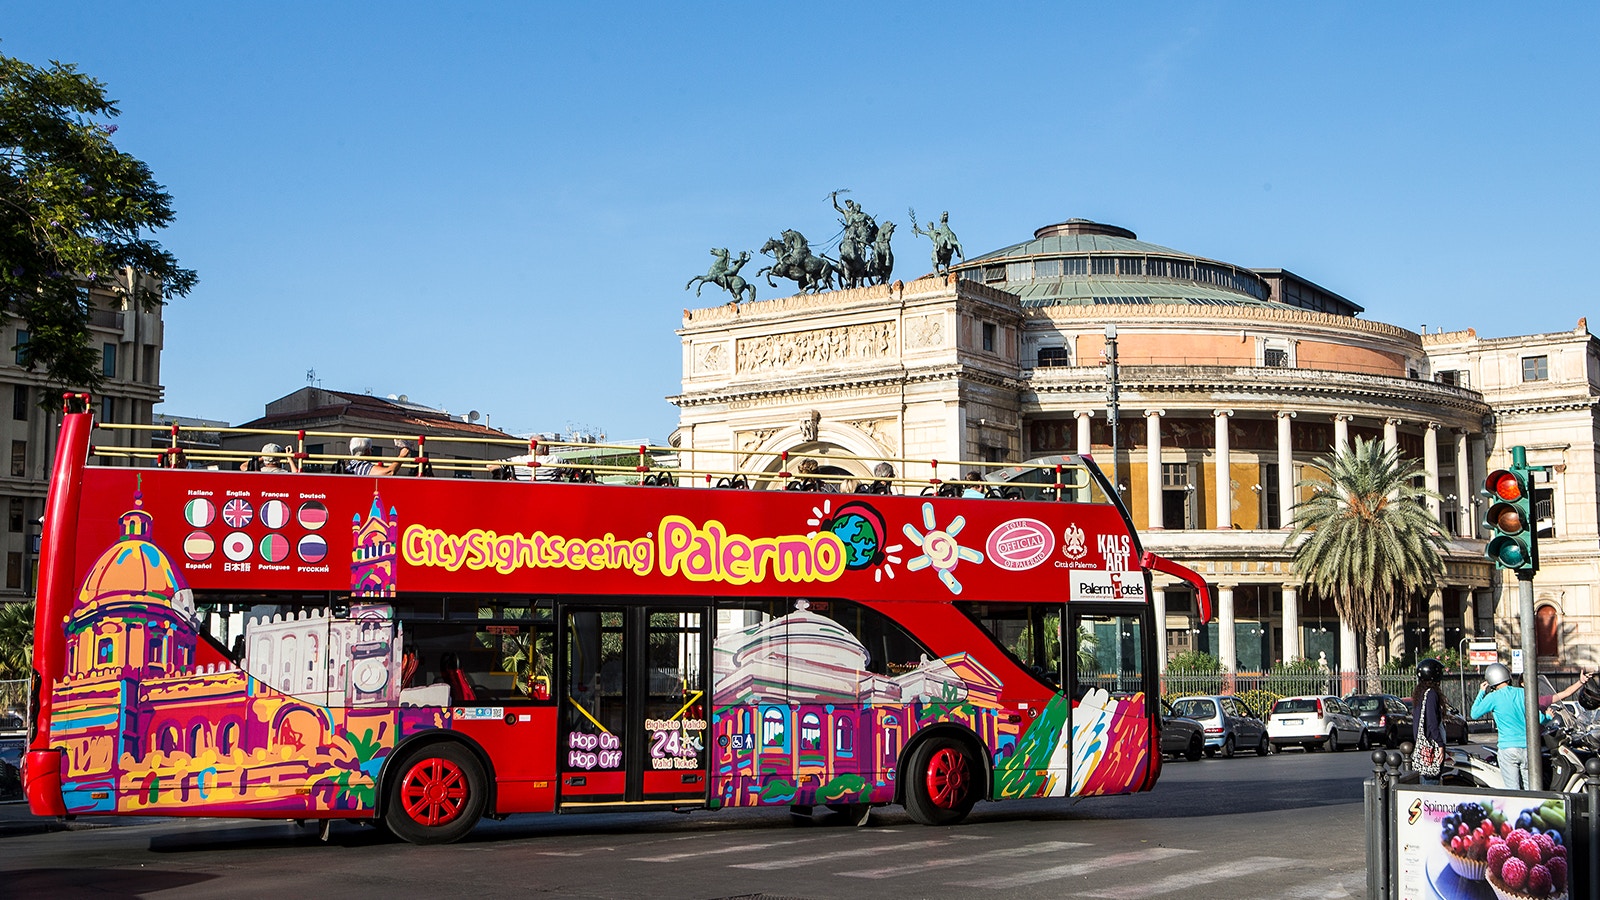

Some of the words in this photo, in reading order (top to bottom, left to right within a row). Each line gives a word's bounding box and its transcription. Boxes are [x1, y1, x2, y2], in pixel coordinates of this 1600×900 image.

[226, 490, 251, 498] English
[1005, 521, 1028, 532] TOUR
[658, 515, 847, 585] Palermo
[999, 535, 1043, 554] OFFICIAL
[1097, 534, 1130, 554] KALS
[1004, 559, 1015, 568] OF
[1015, 551, 1045, 568] PALERMO
[1054, 560, 1069, 568] Città
[1075, 561, 1097, 569] Palermo
[185, 562, 212, 570] Español
[224, 562, 251, 572] 日本語
[645, 719, 680, 731] Biglietto
[682, 719, 707, 730] Valido
[569, 731, 599, 751] Hop
[599, 732, 620, 749] On
[568, 750, 598, 770] Hop
[598, 750, 622, 768] Off
[652, 757, 673, 769] Valid
[674, 757, 698, 769] Ticket
